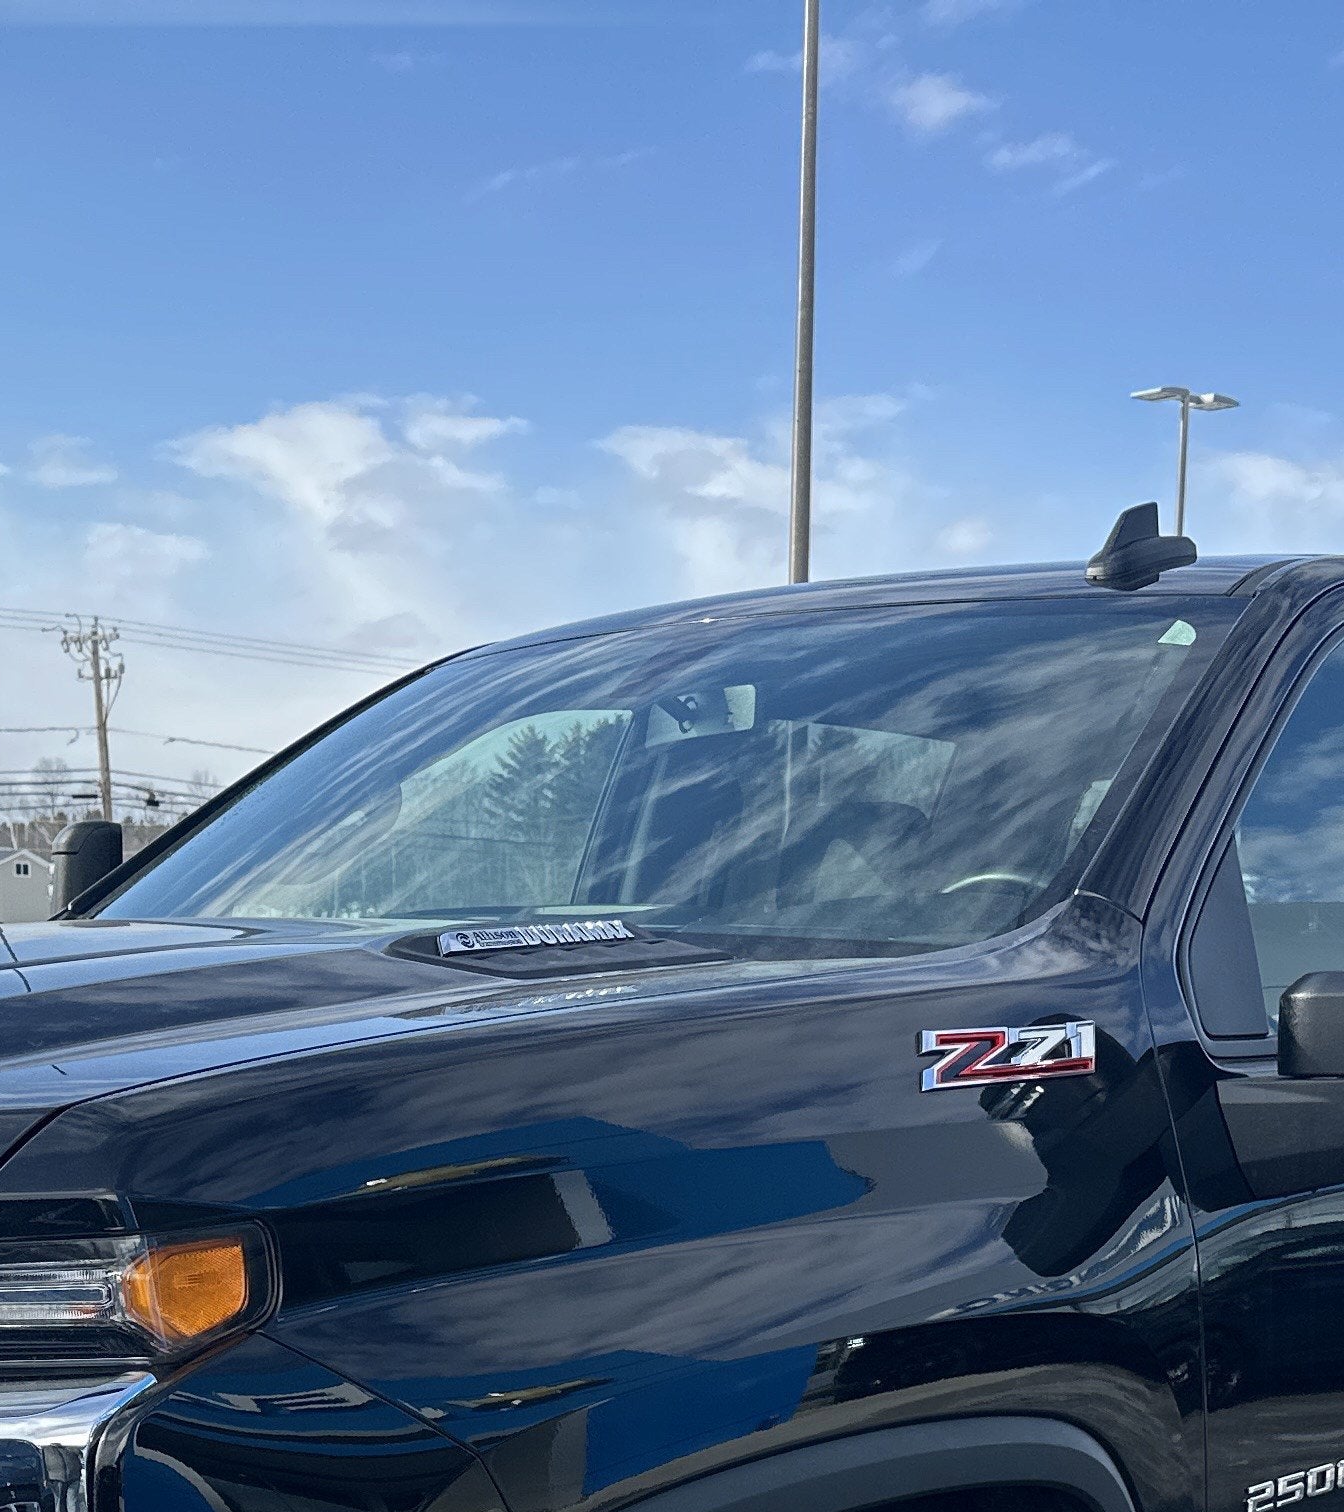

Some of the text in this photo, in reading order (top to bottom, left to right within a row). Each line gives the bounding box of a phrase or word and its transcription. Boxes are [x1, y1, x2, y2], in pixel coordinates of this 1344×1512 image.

[473, 920, 634, 947] Allison DURAMAX
[917, 1020, 1096, 1092] Z71
